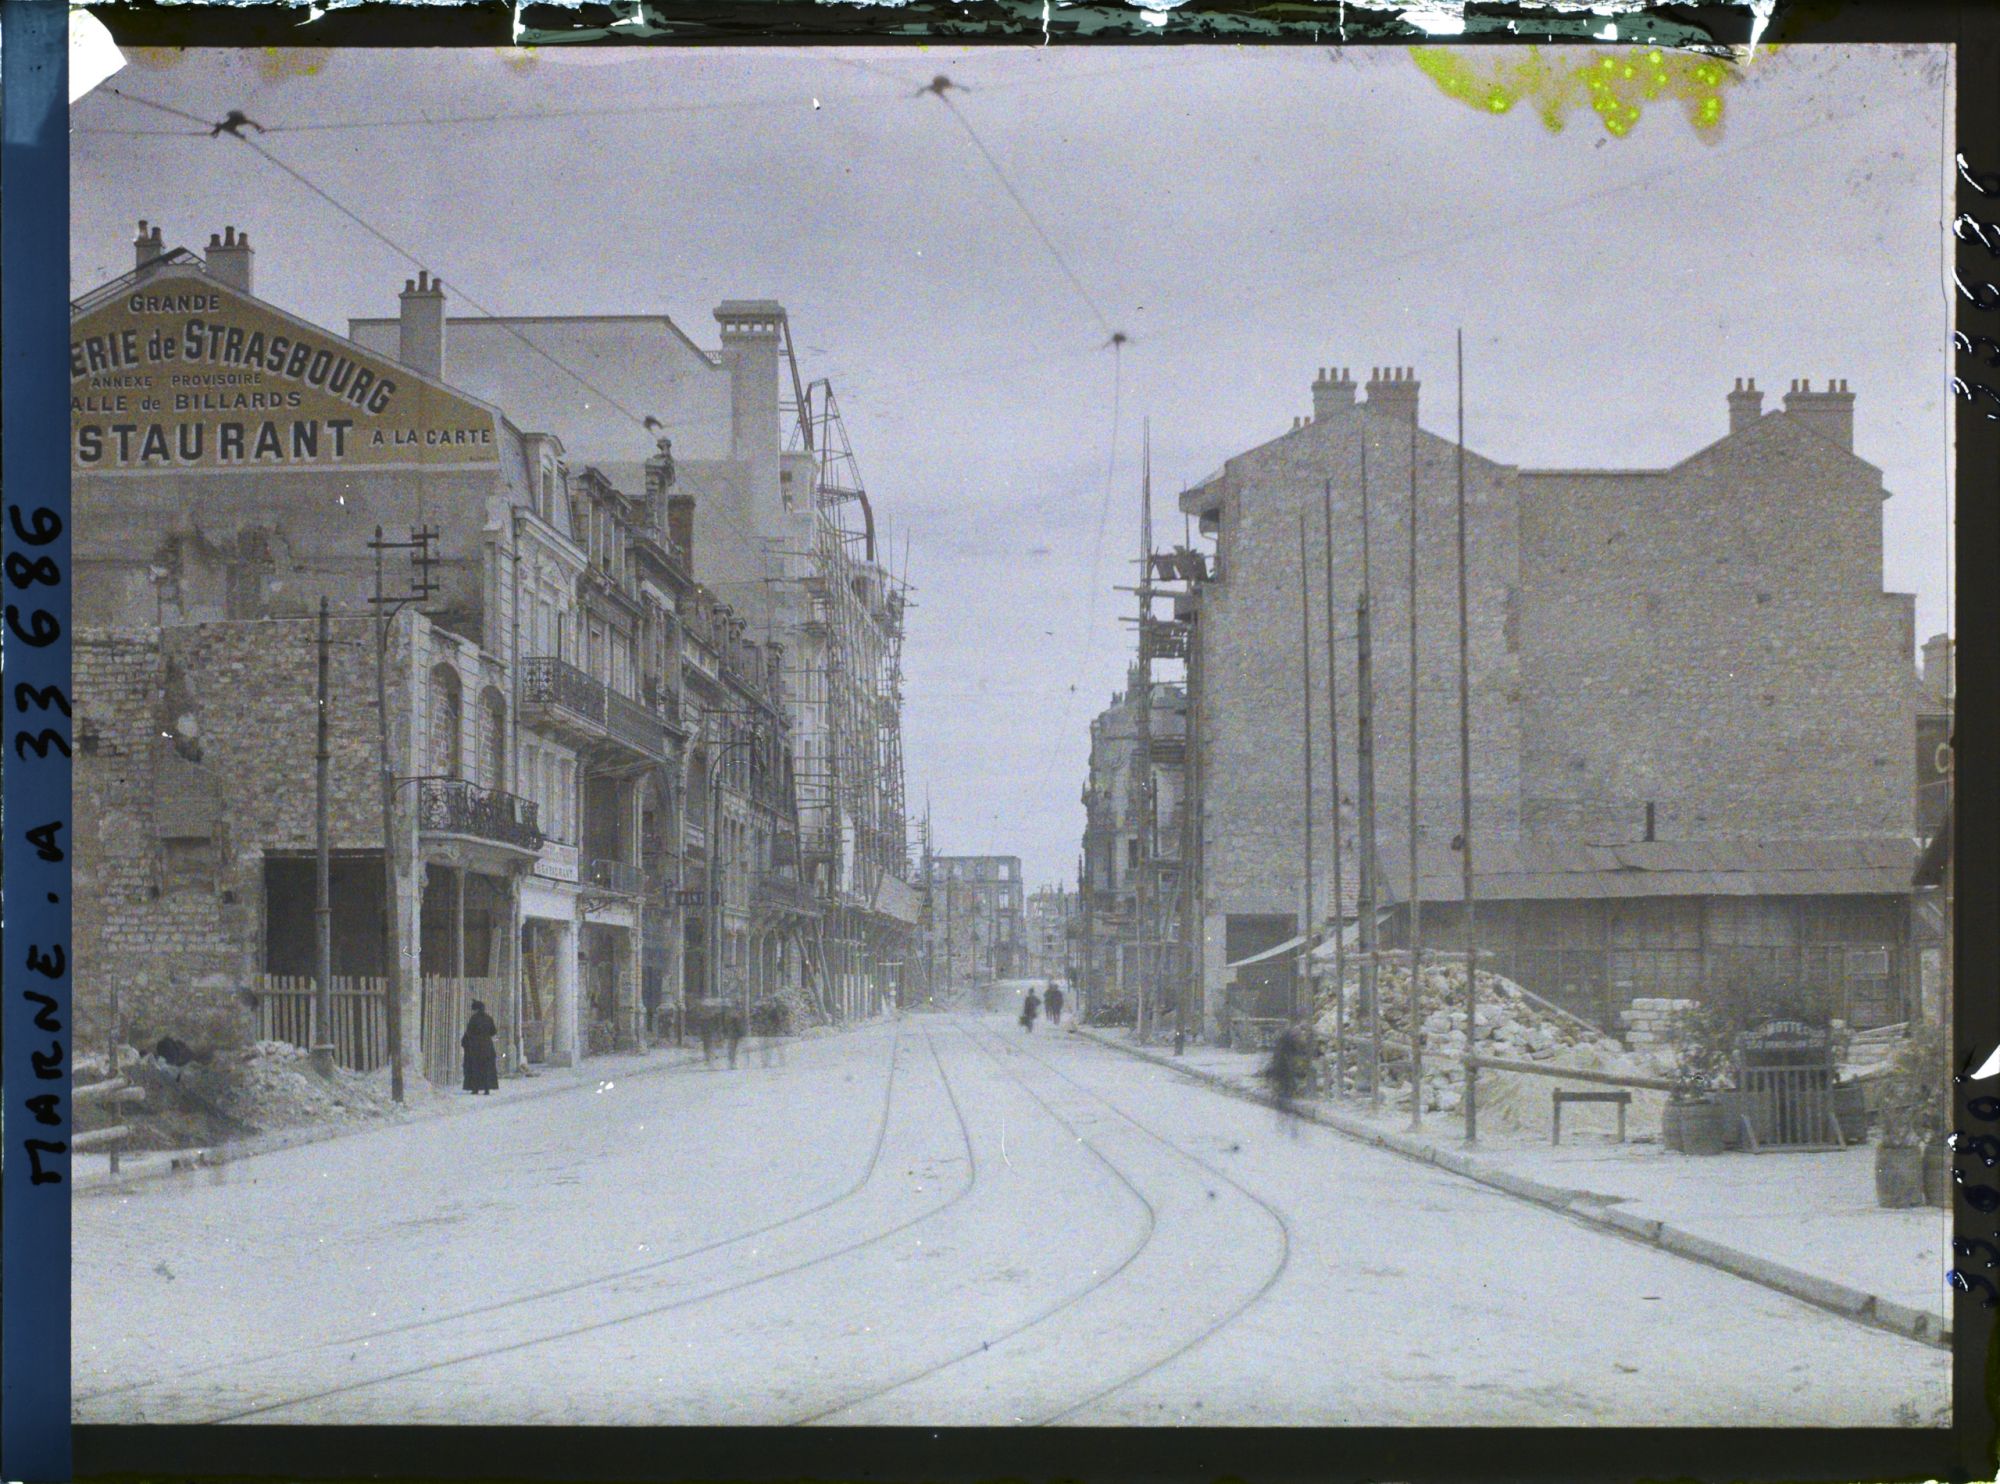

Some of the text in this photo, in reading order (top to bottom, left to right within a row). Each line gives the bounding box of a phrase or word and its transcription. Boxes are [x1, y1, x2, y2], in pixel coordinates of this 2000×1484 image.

[129, 293, 220, 313] GRANDE
[70, 317, 397, 415] ERIE de STRASBOURG
[91, 373, 263, 388] ANNEXE PROVISOIRE
[141, 395, 161, 411] de
[175, 390, 301, 410] BILLARDS
[78, 419, 355, 462] STAURANT
[394, 429, 418, 444] LA
[426, 428, 491, 445] CARTE
[25, 820, 65, 862] A
[23, 944, 67, 1186] MARNE
